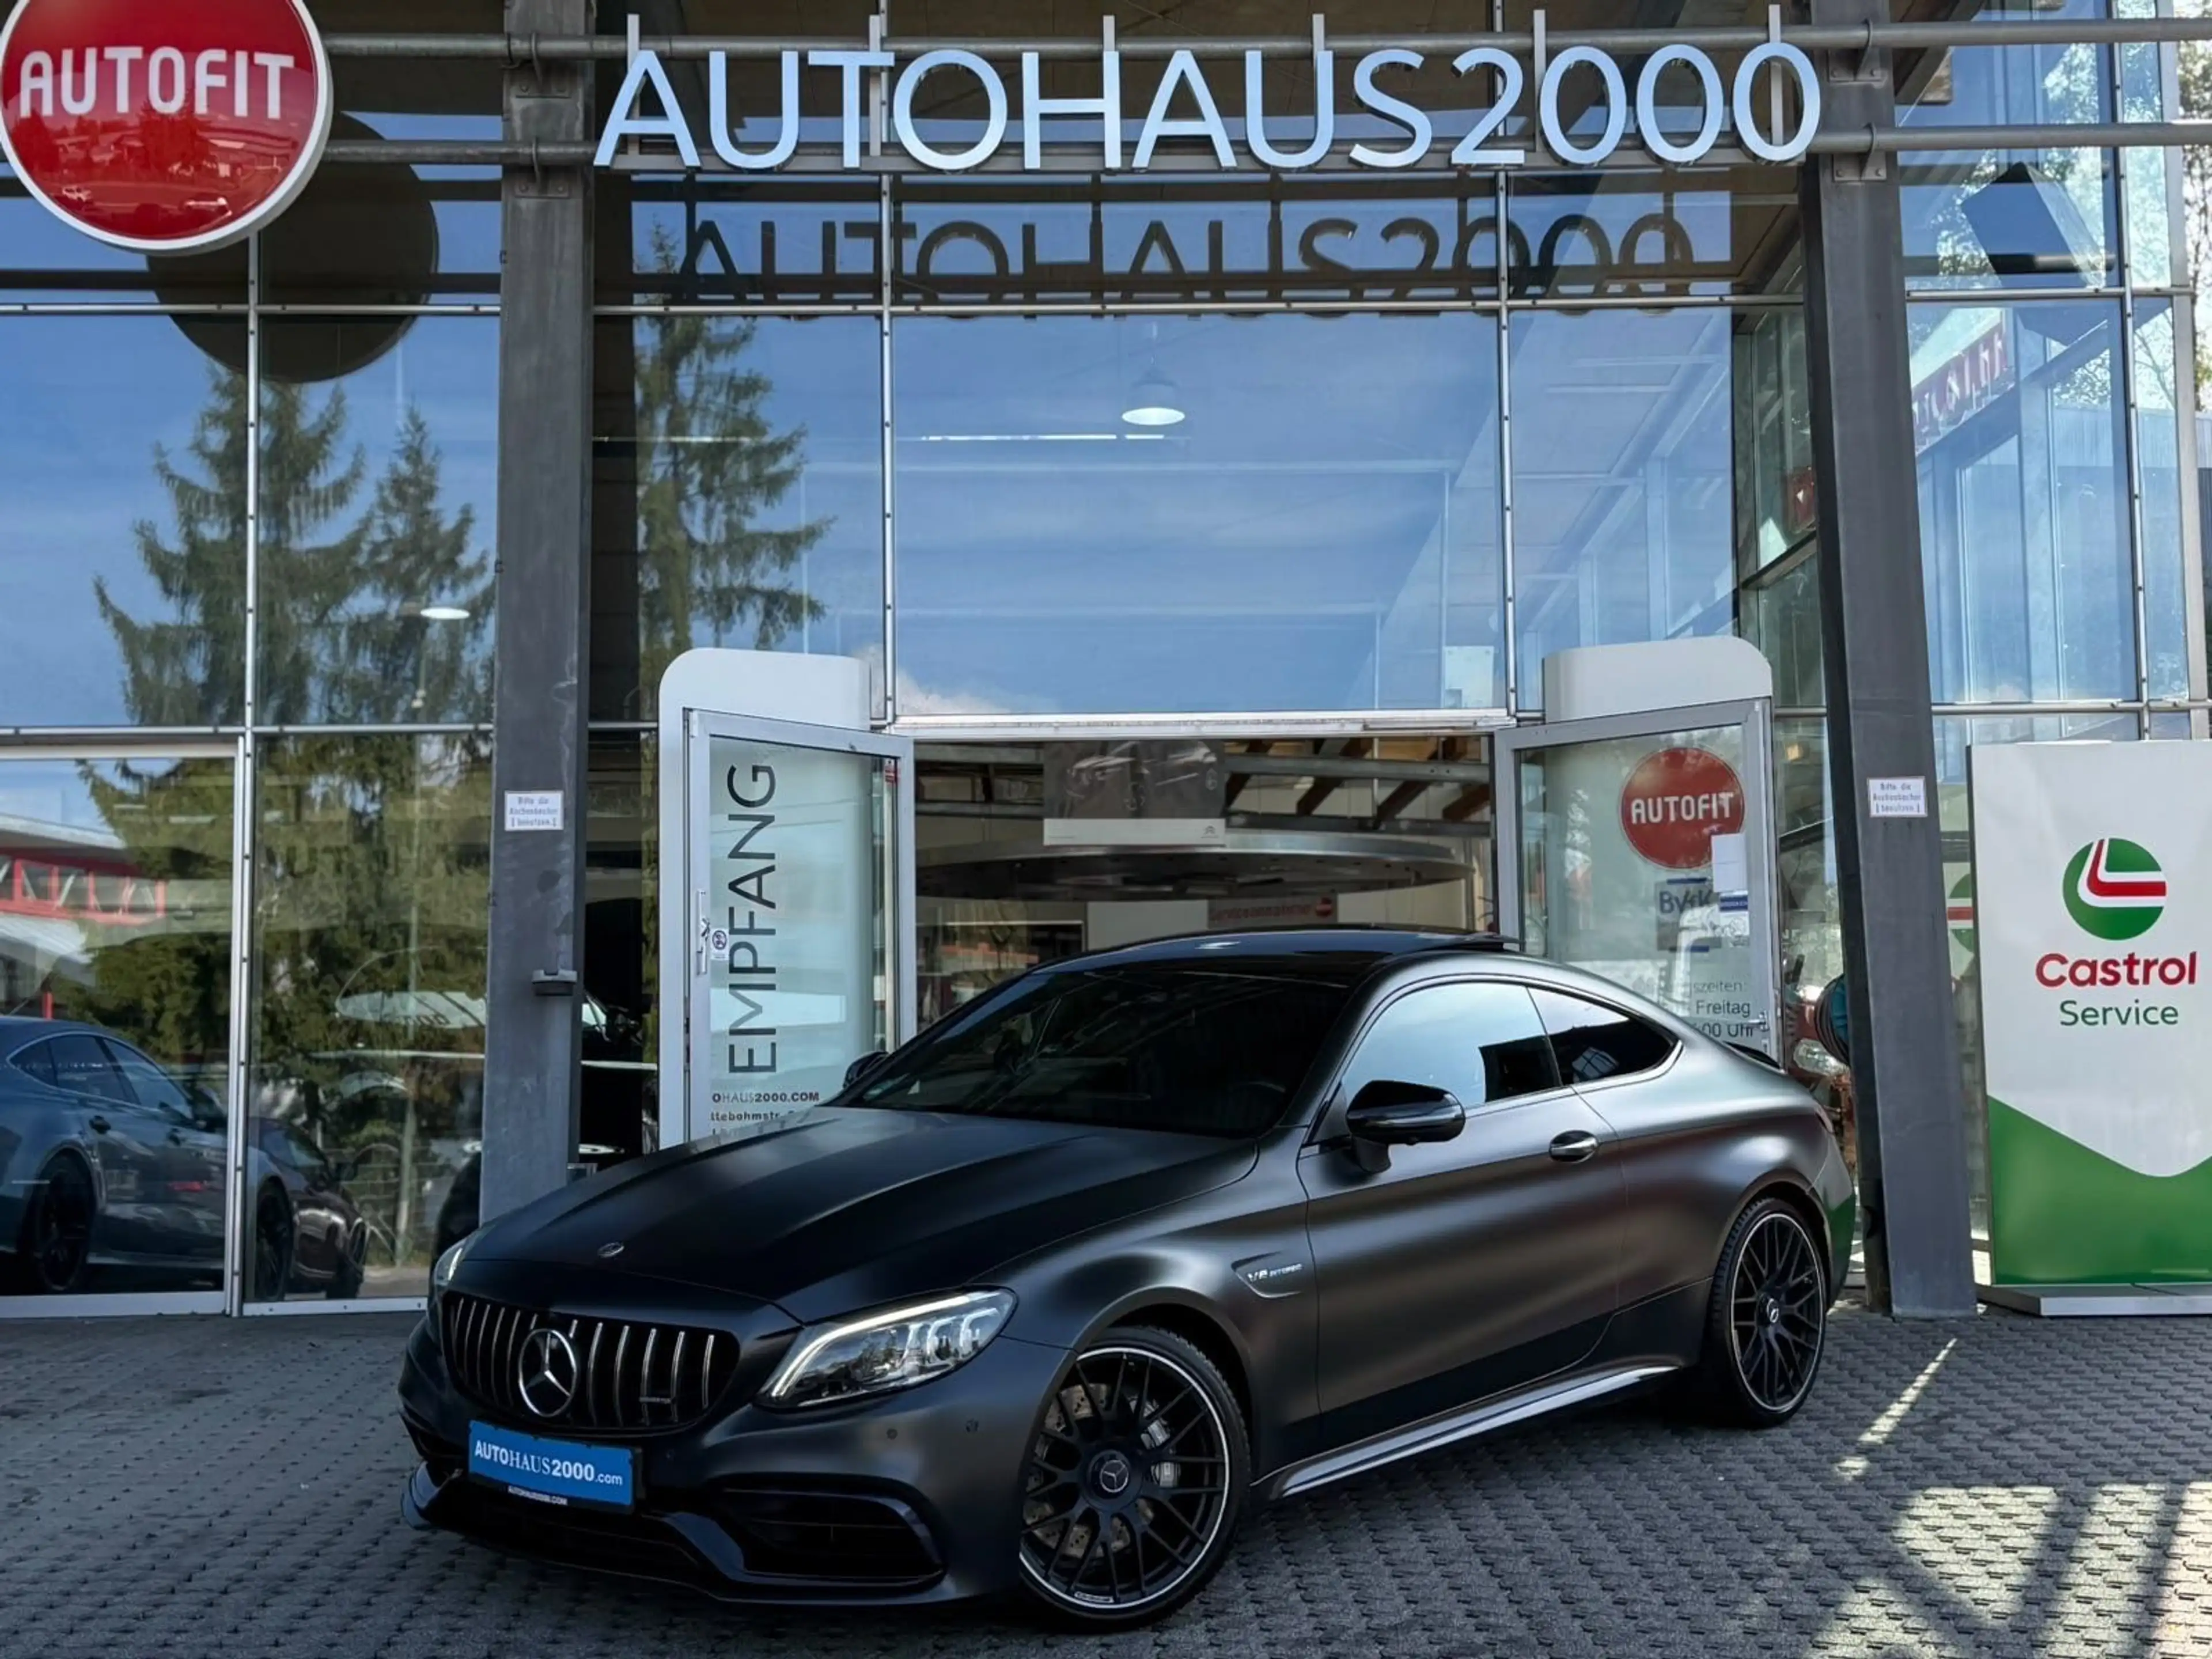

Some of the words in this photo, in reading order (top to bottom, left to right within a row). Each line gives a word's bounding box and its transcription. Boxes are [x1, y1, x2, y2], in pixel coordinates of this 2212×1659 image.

[20, 46, 294, 119] AUTOFIT
[593, 43, 1820, 169] AUTOHAUS2000
[1631, 791, 1734, 824] AUTOFIT
[727, 763, 777, 1074] EMPFANG
[2035, 952, 2198, 987] Castrol
[1696, 999, 1751, 1018] Freitag
[2059, 999, 2179, 1026] Service
[475, 1440, 623, 1486] AUTOHAUS2000.com
